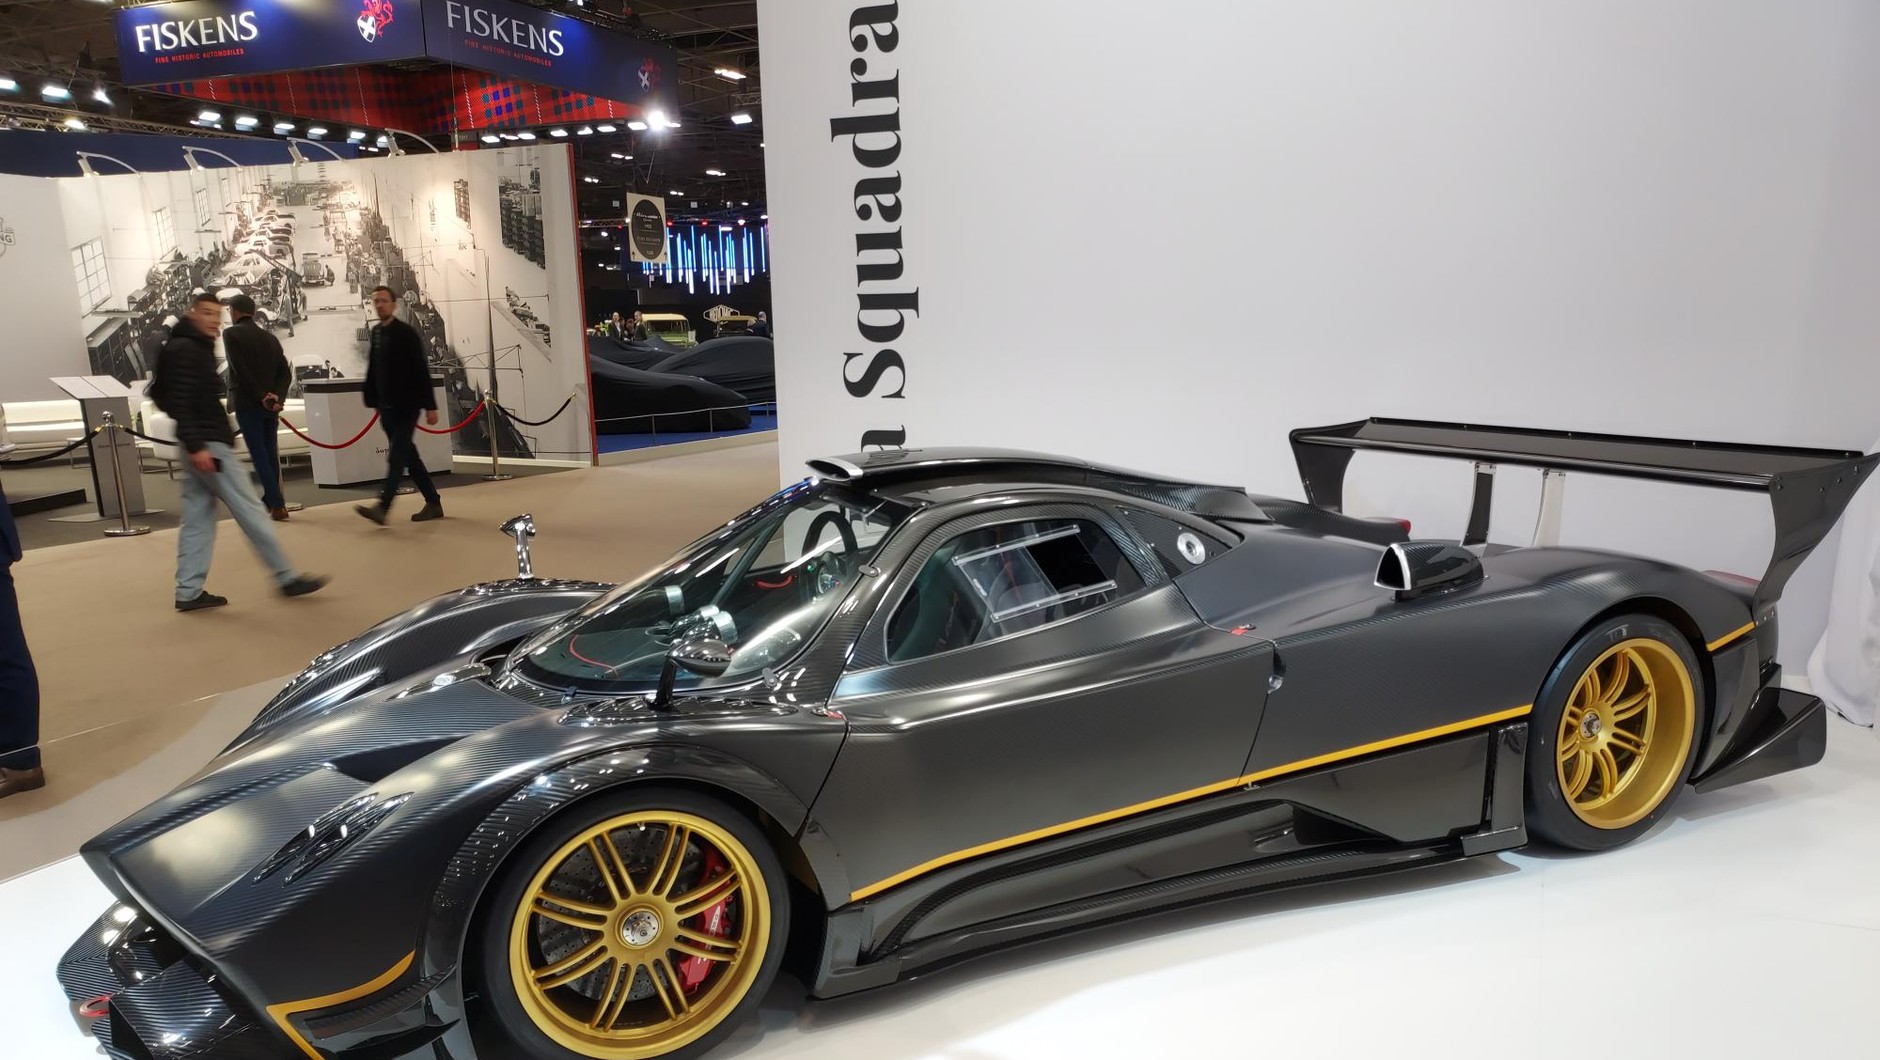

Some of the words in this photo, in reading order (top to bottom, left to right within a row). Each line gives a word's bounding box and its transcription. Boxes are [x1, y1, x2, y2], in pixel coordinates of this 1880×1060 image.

[135, 11, 259, 53] FISKENS
[446, 1, 564, 57] FISKENS
[155, 56, 169, 64] FINE
[171, 53, 200, 62] HISTORIC
[202, 48, 245, 59] AUTOMOBILES
[829, 0, 920, 399] Squadra
